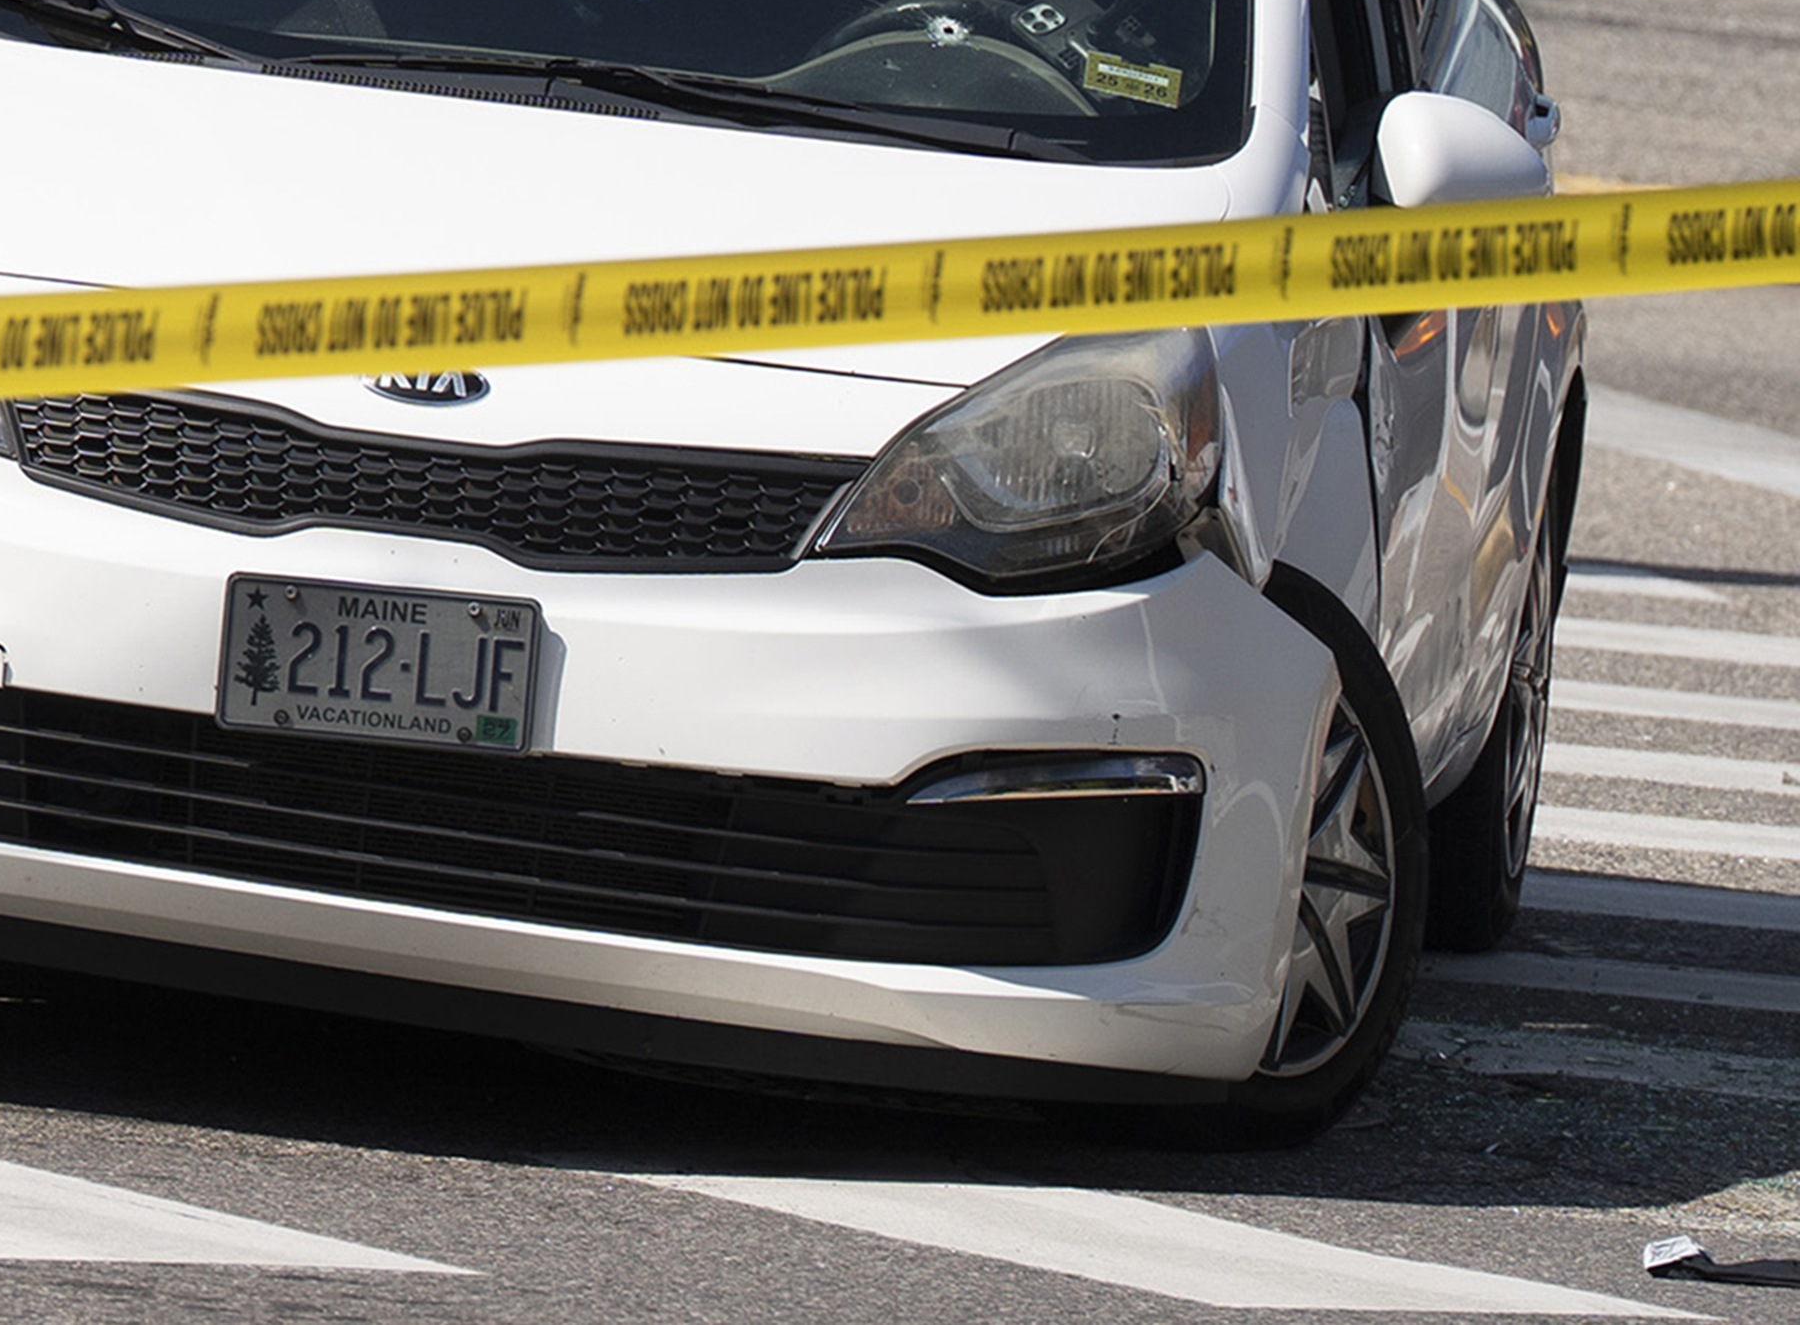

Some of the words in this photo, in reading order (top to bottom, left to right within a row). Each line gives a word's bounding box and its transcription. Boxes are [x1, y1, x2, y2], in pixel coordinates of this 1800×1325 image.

[1095, 72, 1119, 87] 25
[1143, 83, 1168, 98] 26
[1437, 228, 1463, 282] DO
[1467, 225, 1508, 279] LINE
[1513, 219, 1579, 275] POLICE
[1667, 210, 1726, 266] CROSS
[1731, 207, 1768, 262] NOT
[1771, 203, 1797, 258] DO
[981, 257, 1045, 312] CROSS
[1048, 254, 1086, 308] NOT
[1091, 252, 1119, 305] DO
[1123, 249, 1165, 303] LINE
[1169, 243, 1238, 299] POLICE
[1329, 234, 1391, 289] CROSS
[1395, 231, 1432, 285] NOT
[404, 293, 451, 348] LINE
[454, 286, 529, 343] POLICE
[622, 278, 688, 336] CROSS
[691, 277, 731, 331] NOT
[735, 274, 764, 328] DO
[768, 272, 813, 326] LINE
[816, 266, 888, 323] POLICE
[0, 316, 31, 370] DO
[32, 314, 81, 367] LINE
[83, 306, 159, 365] POLICE
[255, 299, 323, 357] CROSS
[326, 298, 368, 352] NOT
[371, 296, 402, 350] DO
[338, 595, 428, 624] MAINE
[494, 608, 521, 630] JUN
[296, 705, 453, 735] VACATIONLAND
